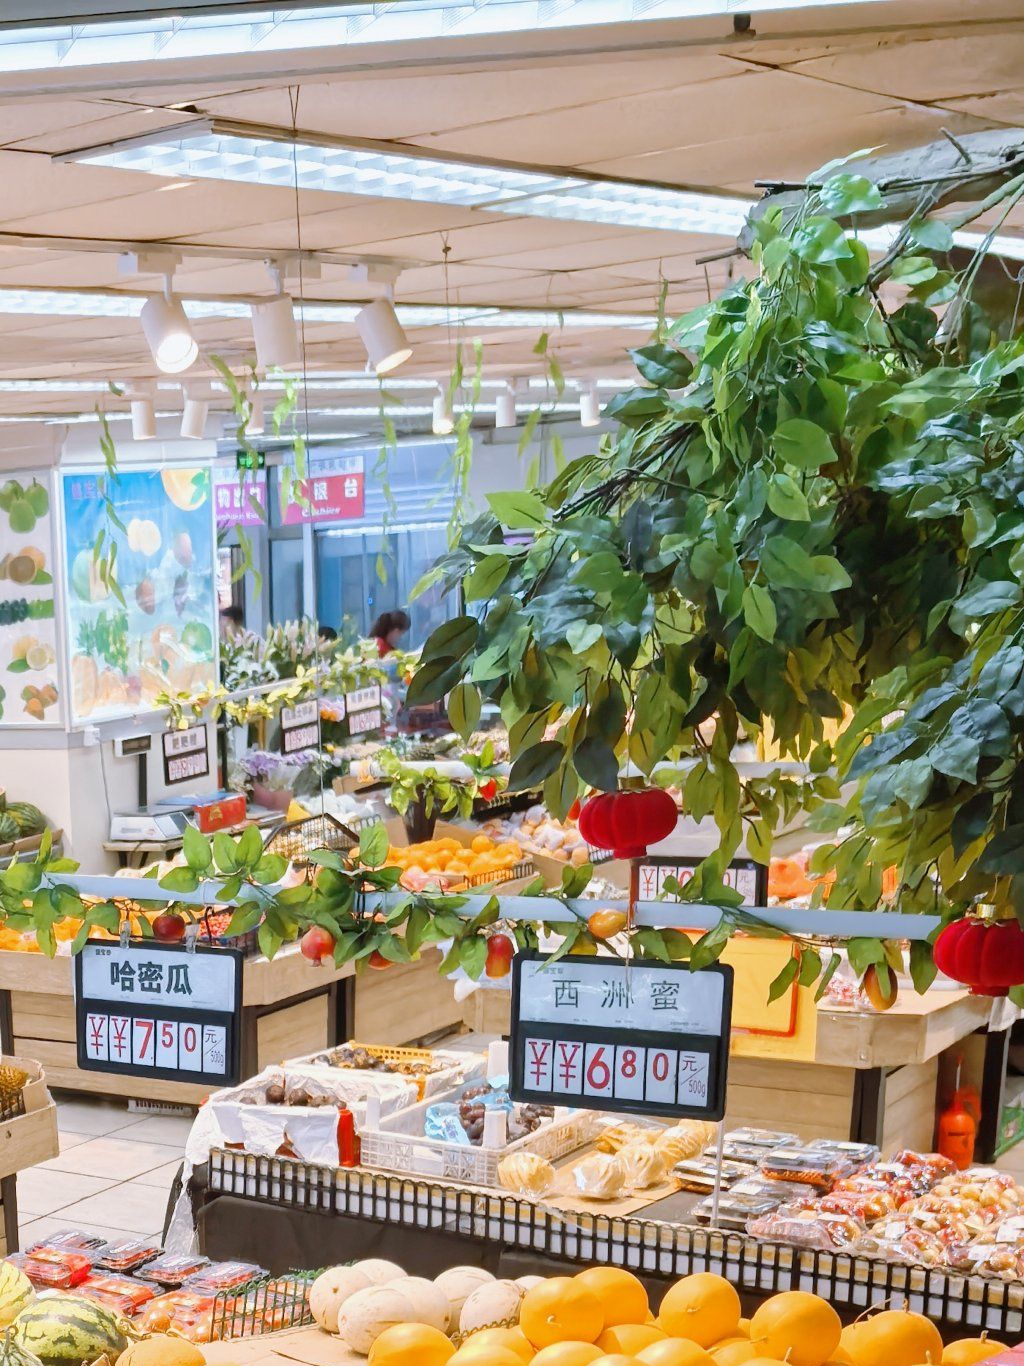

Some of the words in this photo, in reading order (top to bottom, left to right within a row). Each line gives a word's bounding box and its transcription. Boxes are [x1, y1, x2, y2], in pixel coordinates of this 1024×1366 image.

[110, 960, 193, 996] 哈密瓜
[552, 979, 680, 1011] 西洲蜜
[680, 1055, 707, 1098] 元/500g
